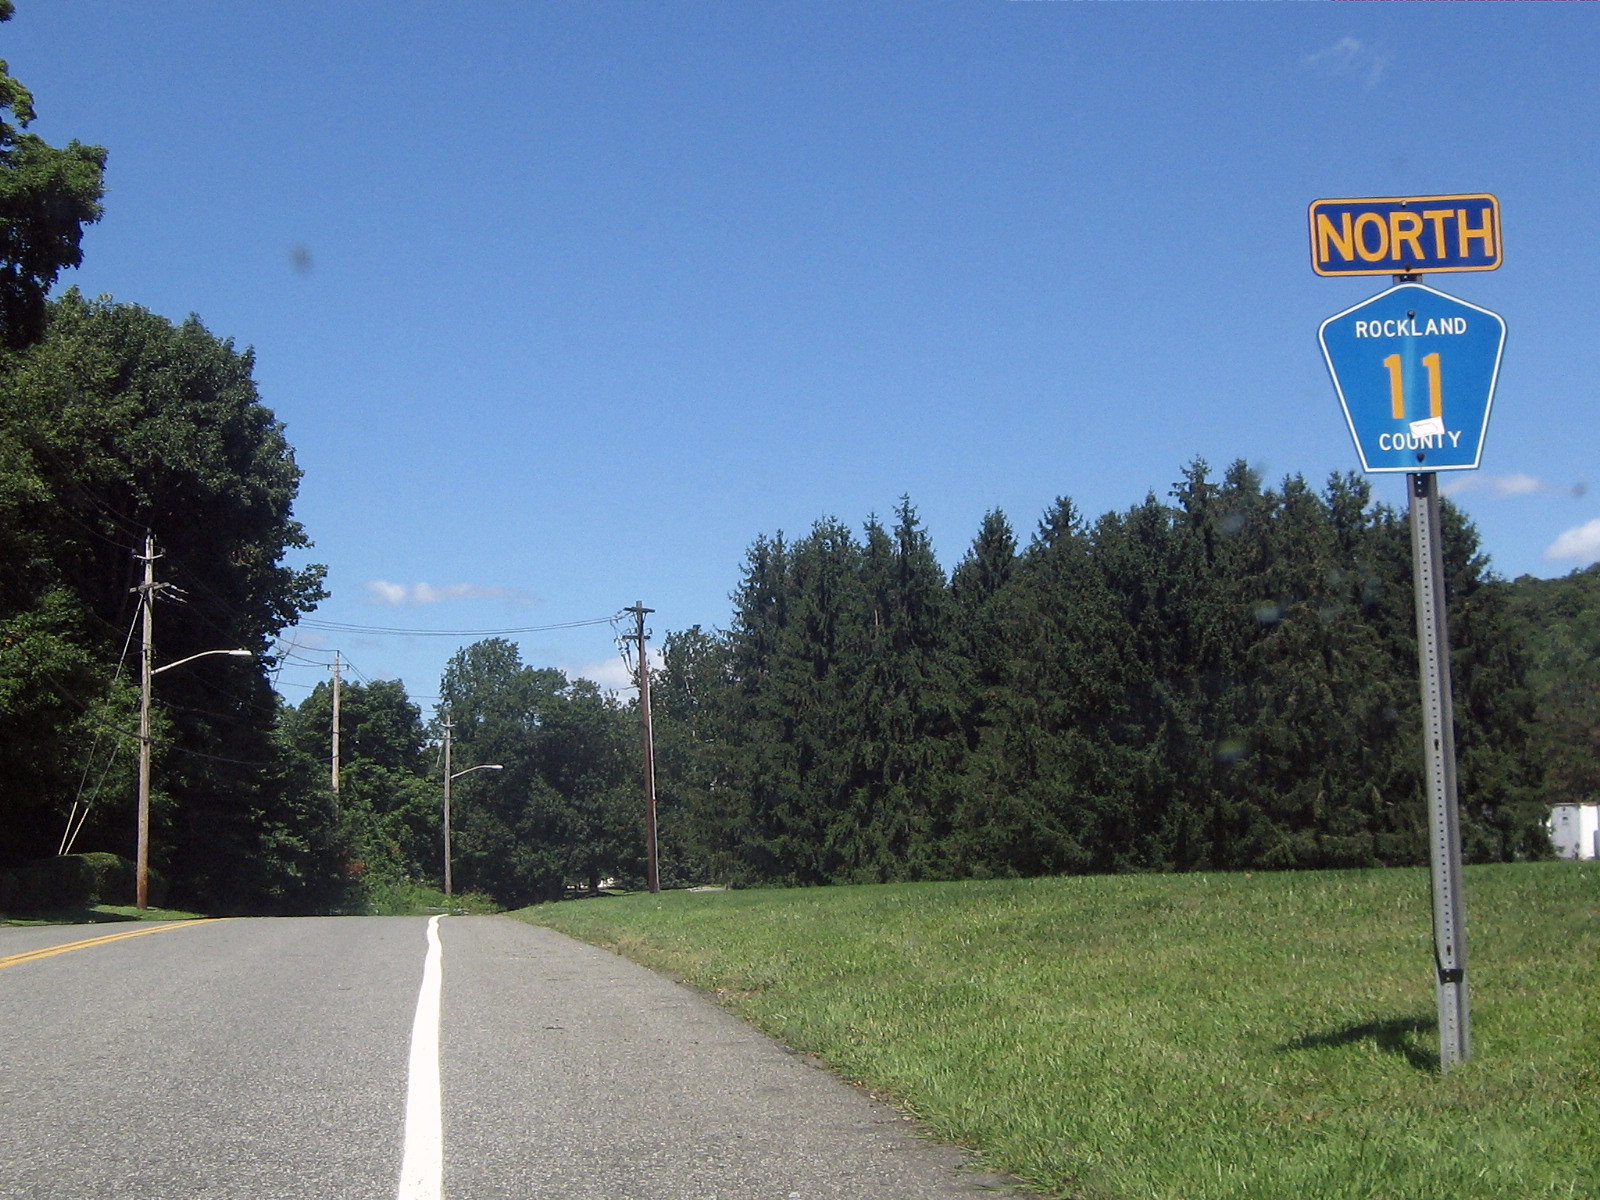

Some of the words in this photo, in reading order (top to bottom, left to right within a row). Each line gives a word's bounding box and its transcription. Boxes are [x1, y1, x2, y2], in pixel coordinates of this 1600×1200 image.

[1317, 208, 1494, 262] NORTH
[1355, 317, 1467, 338] ROCKLAND
[1383, 353, 1443, 419] 11
[1379, 431, 1462, 451] COUNTY
